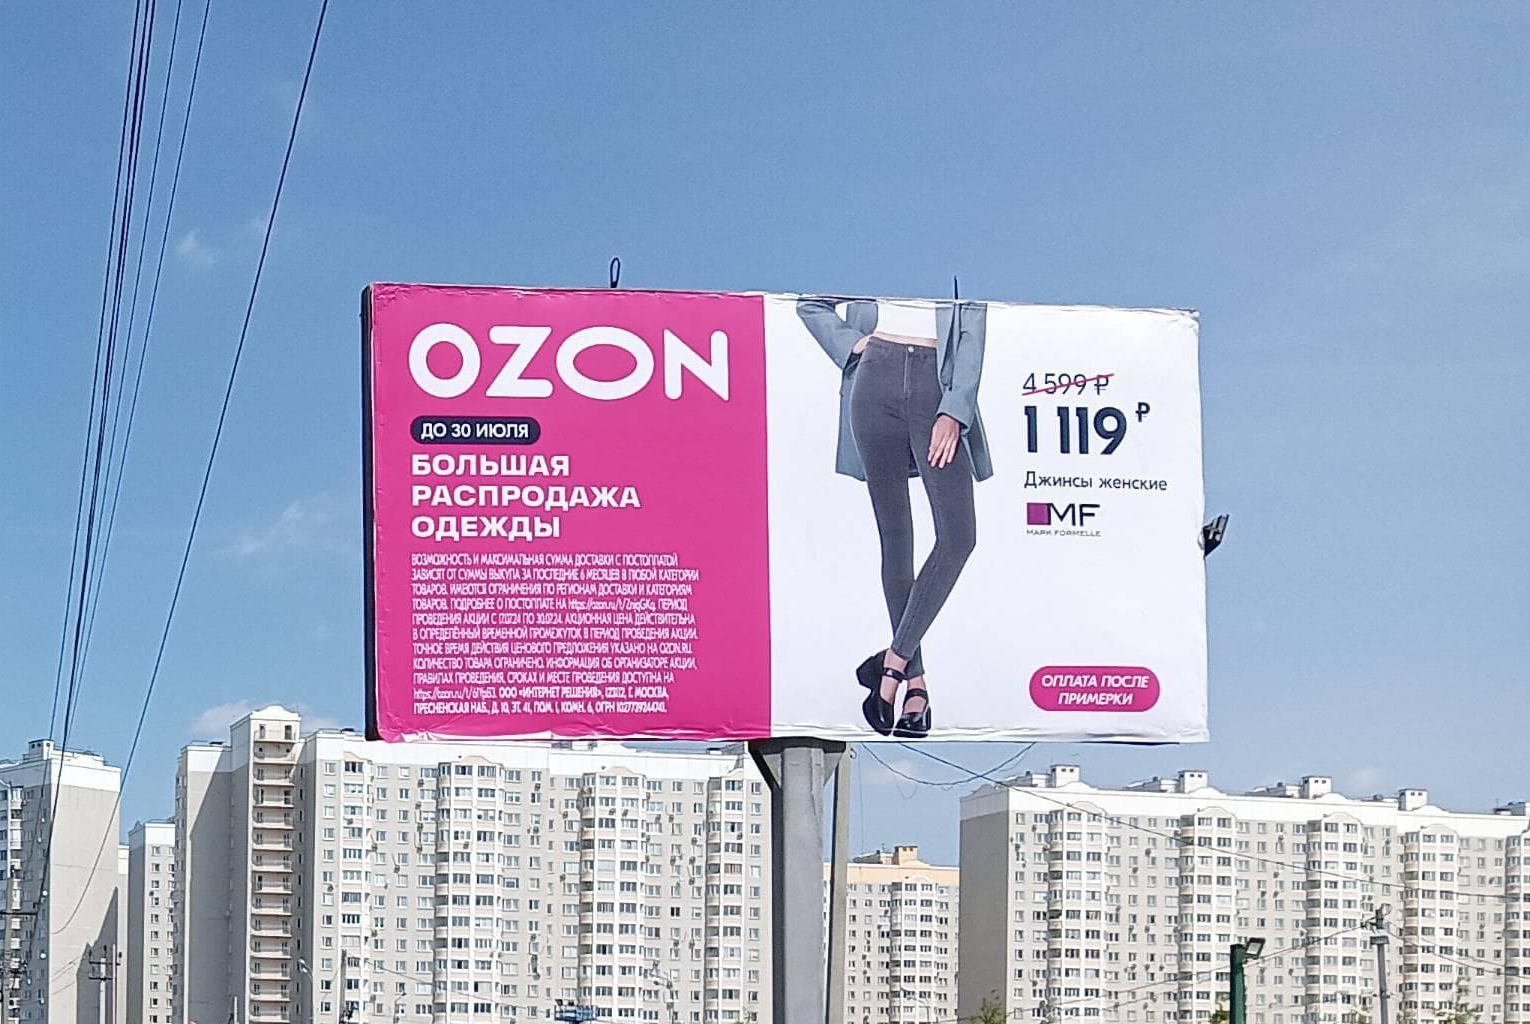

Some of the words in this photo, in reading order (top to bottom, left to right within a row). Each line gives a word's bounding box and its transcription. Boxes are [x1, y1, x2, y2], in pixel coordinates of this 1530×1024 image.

[408, 323, 730, 401] OZON
[420, 423, 446, 440] ДО
[451, 424, 472, 438] 30
[476, 423, 529, 438] ИЮЛЯ
[411, 455, 569, 477] БОЛЬШАЯ
[1024, 471, 1092, 489] Джинсы
[1099, 474, 1168, 491] женские
[411, 486, 641, 511] РАСПРОДАЖА
[1047, 503, 1100, 526] MF
[411, 516, 560, 541] ОДЕЖДЫ
[1042, 675, 1098, 688] ОПЛАТА
[1101, 676, 1149, 689] ПОСЛЕ
[1058, 692, 1133, 705] ПРИМЕРКИ
